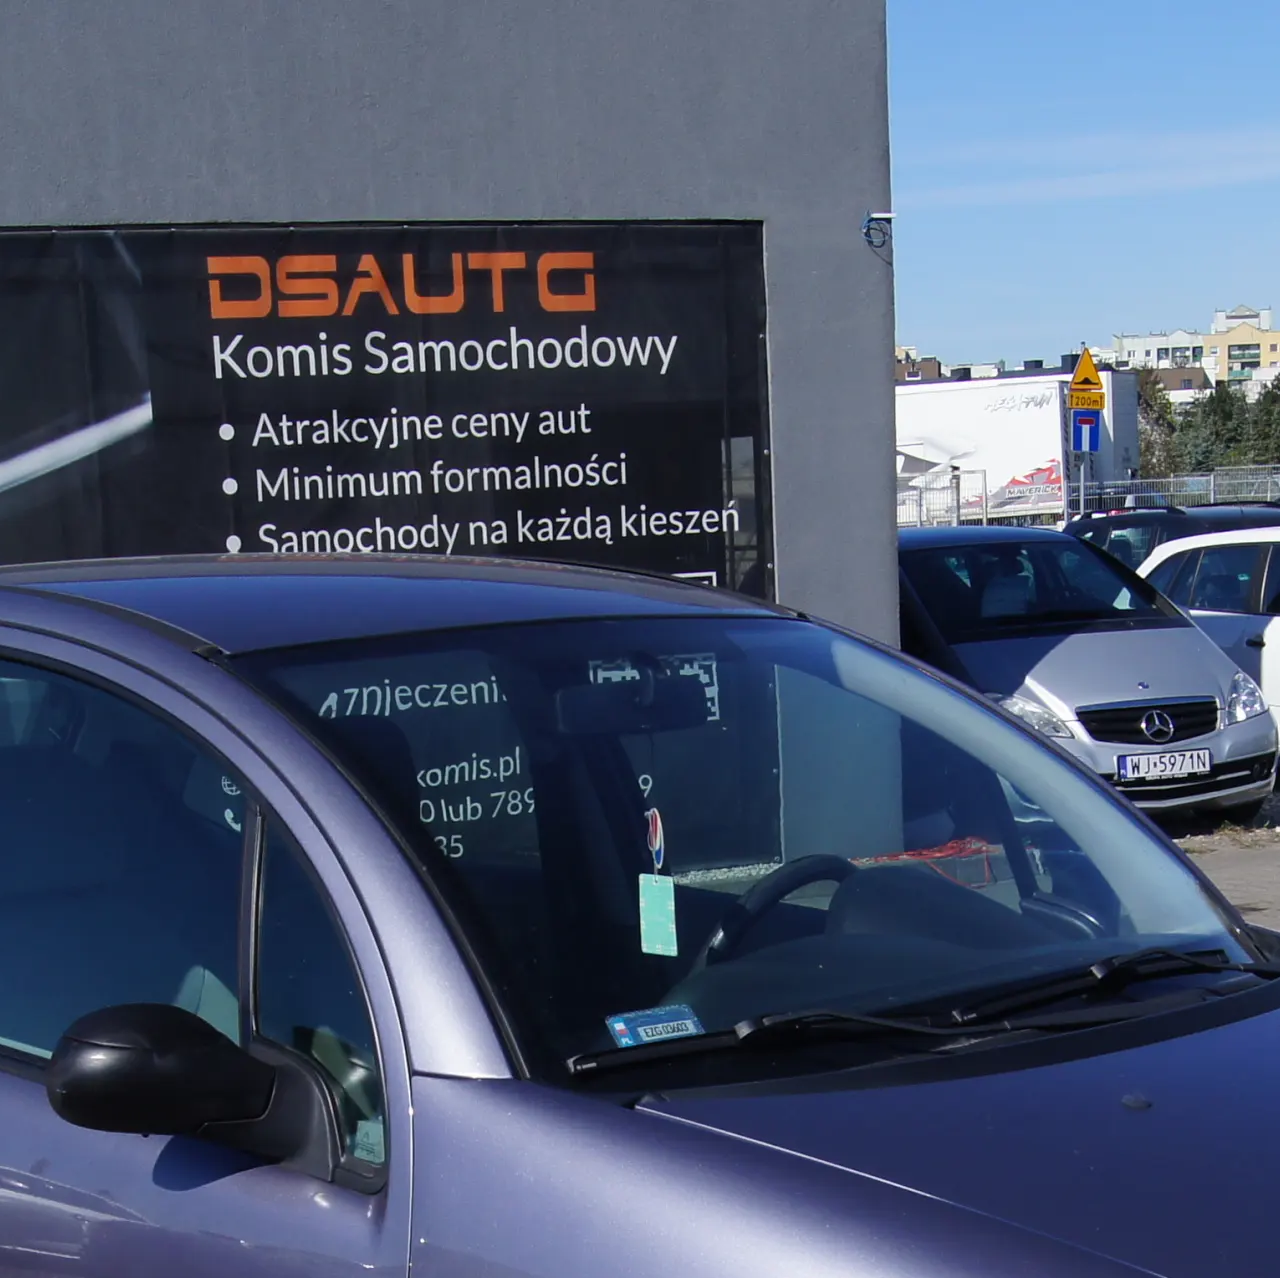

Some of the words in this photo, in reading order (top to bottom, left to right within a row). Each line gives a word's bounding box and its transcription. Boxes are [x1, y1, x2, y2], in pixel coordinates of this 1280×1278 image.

[212, 331, 353, 380] Komis
[363, 325, 678, 375] Samochodowy
[251, 407, 443, 449] Atrakcyjne
[451, 409, 530, 443] ceny
[538, 403, 592, 435] aut
[255, 464, 423, 502] Minimum
[430, 452, 628, 495] formalności
[258, 514, 460, 555] Samochody
[469, 517, 508, 545] na
[517, 507, 613, 545] każdą
[620, 501, 740, 537] kieszeń
[1158, 752, 1207, 773] 5971N
[441, 796, 483, 823] lub
[643, 1025, 663, 1038] EZG
